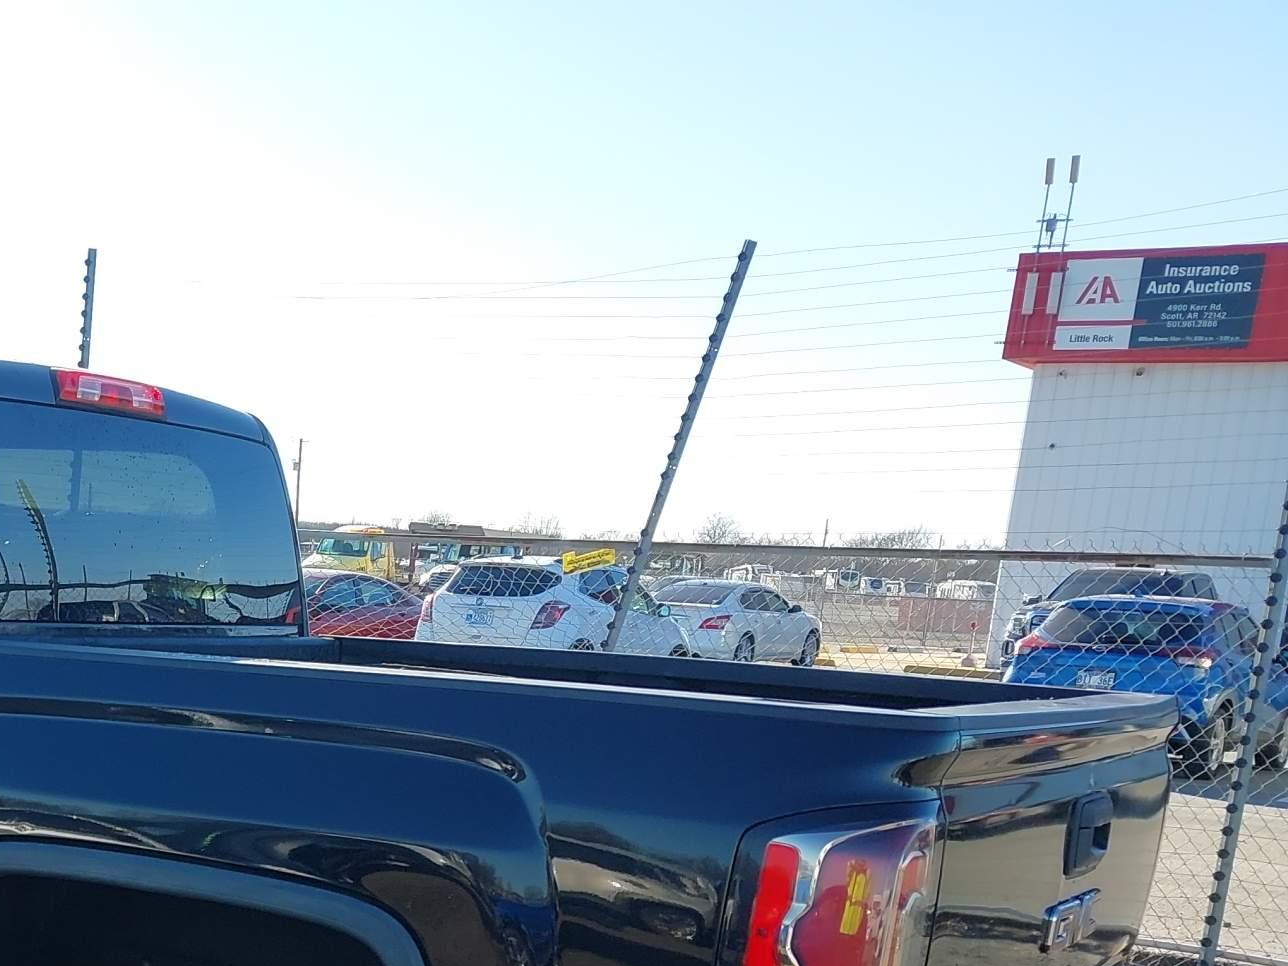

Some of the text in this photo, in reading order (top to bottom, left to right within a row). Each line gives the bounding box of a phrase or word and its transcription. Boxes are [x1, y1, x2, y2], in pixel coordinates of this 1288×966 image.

[1164, 263, 1240, 277] Insurance
[1145, 279, 1253, 294] Auto Auctions
[1167, 304, 1188, 312] 4900
[1209, 303, 1222, 311] Rd
[1069, 334, 1114, 343] Little Rock
